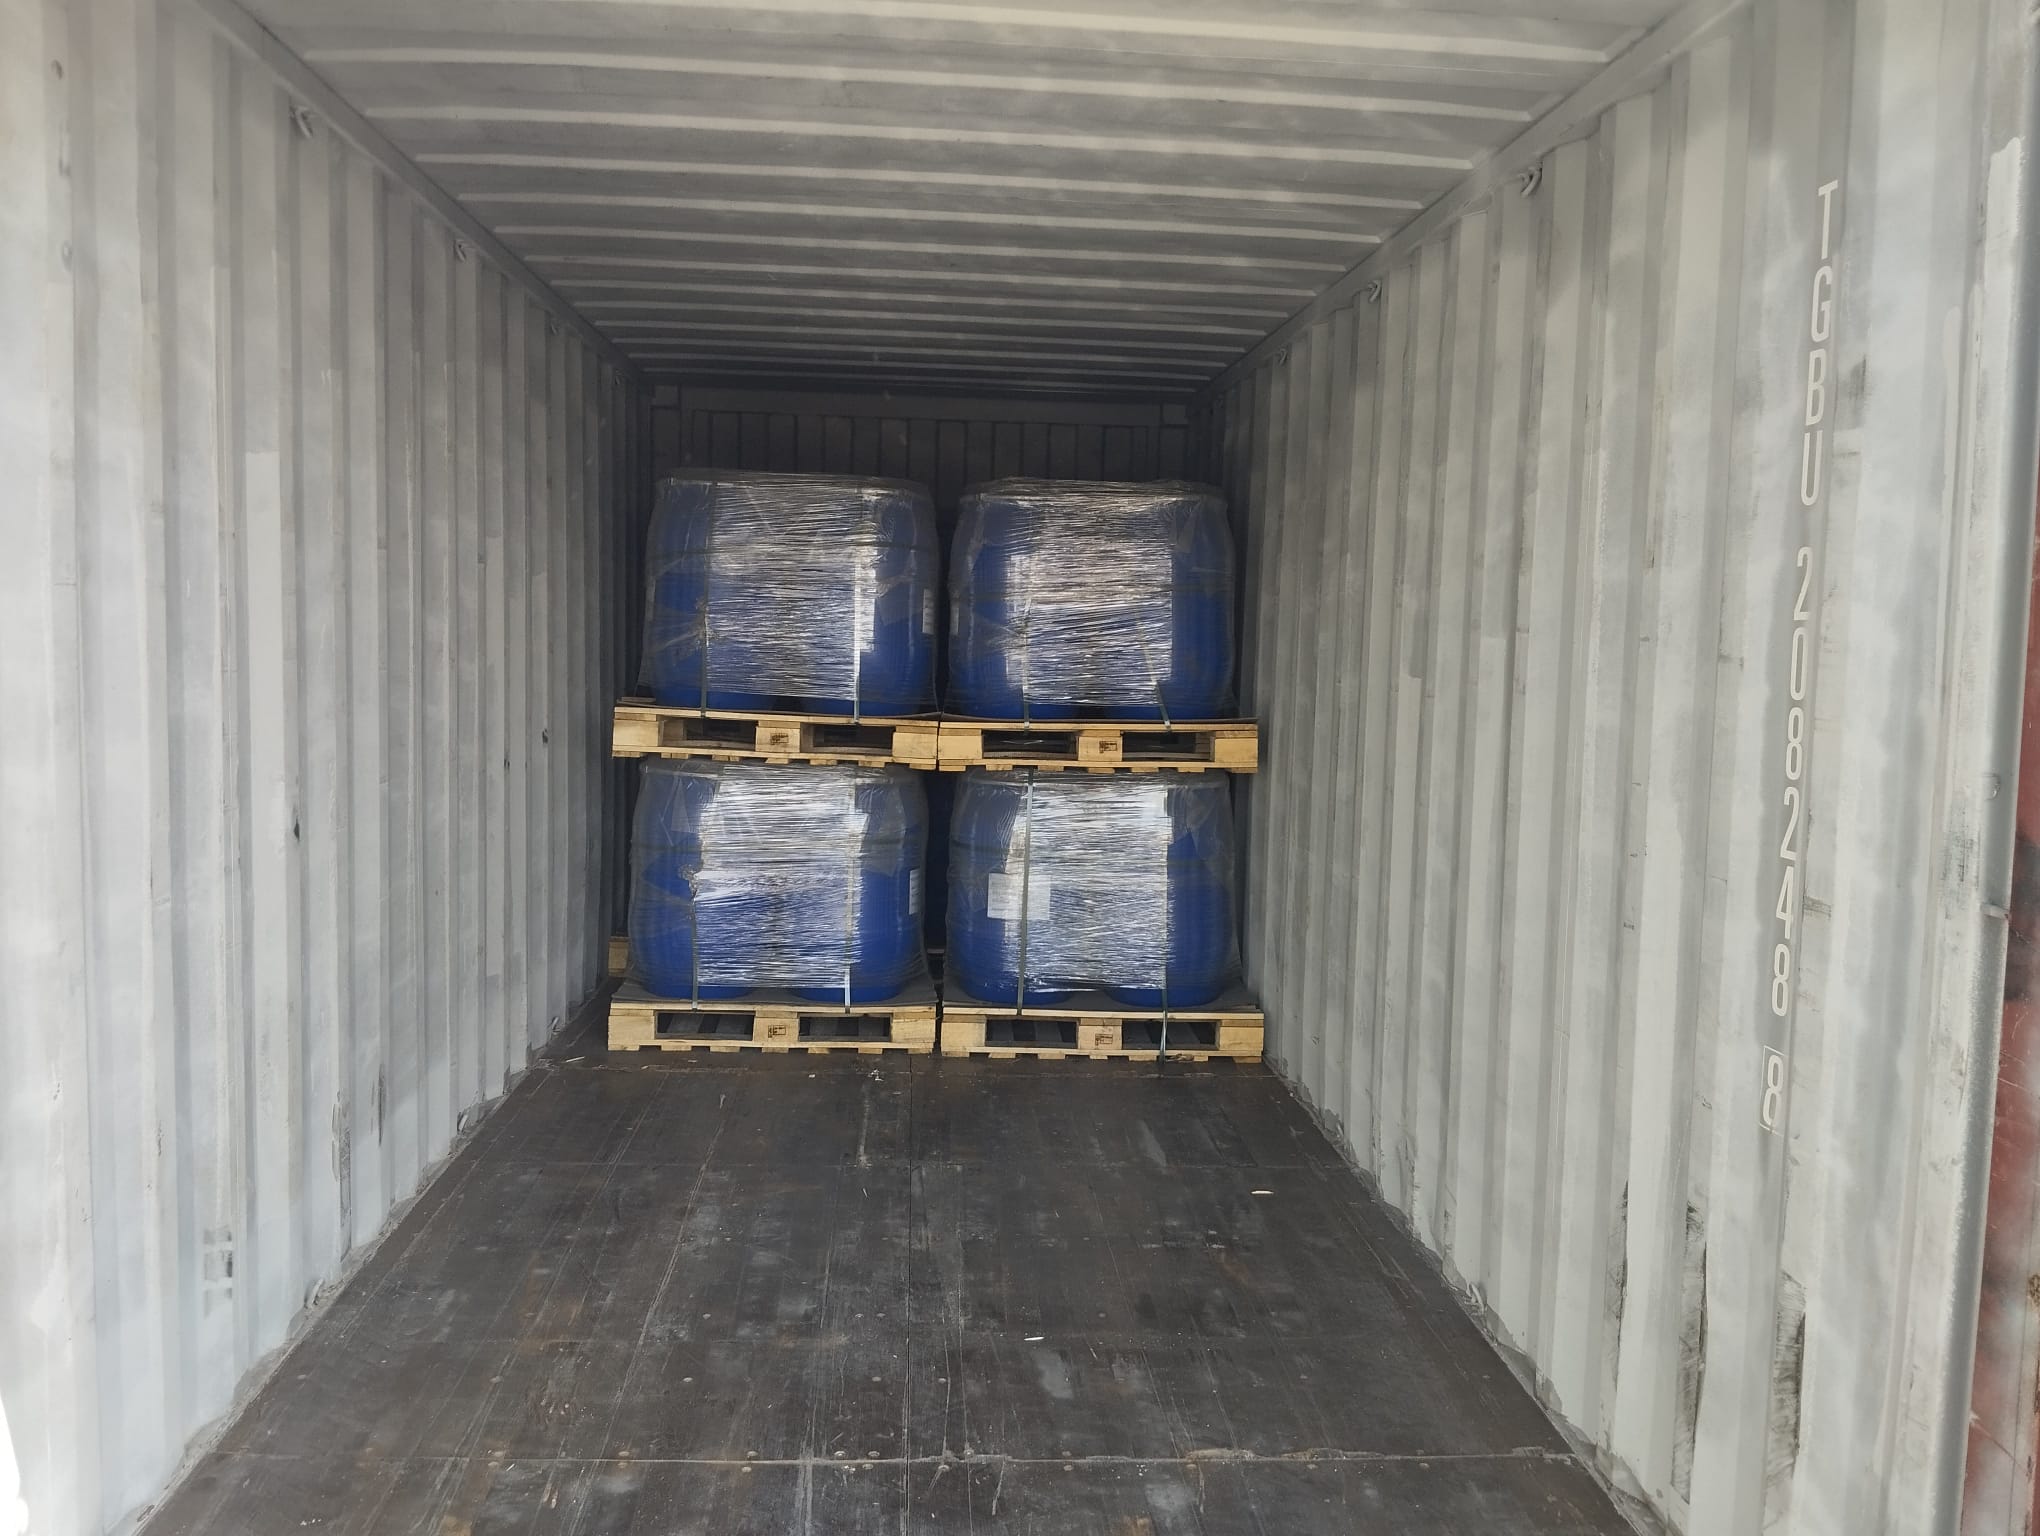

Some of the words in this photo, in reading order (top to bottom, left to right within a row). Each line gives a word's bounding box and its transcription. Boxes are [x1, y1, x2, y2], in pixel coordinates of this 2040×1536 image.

[1801, 179, 1838, 506] TGBU
[1771, 546, 1812, 1017] 208248
[1762, 1054, 1784, 1127] 8
